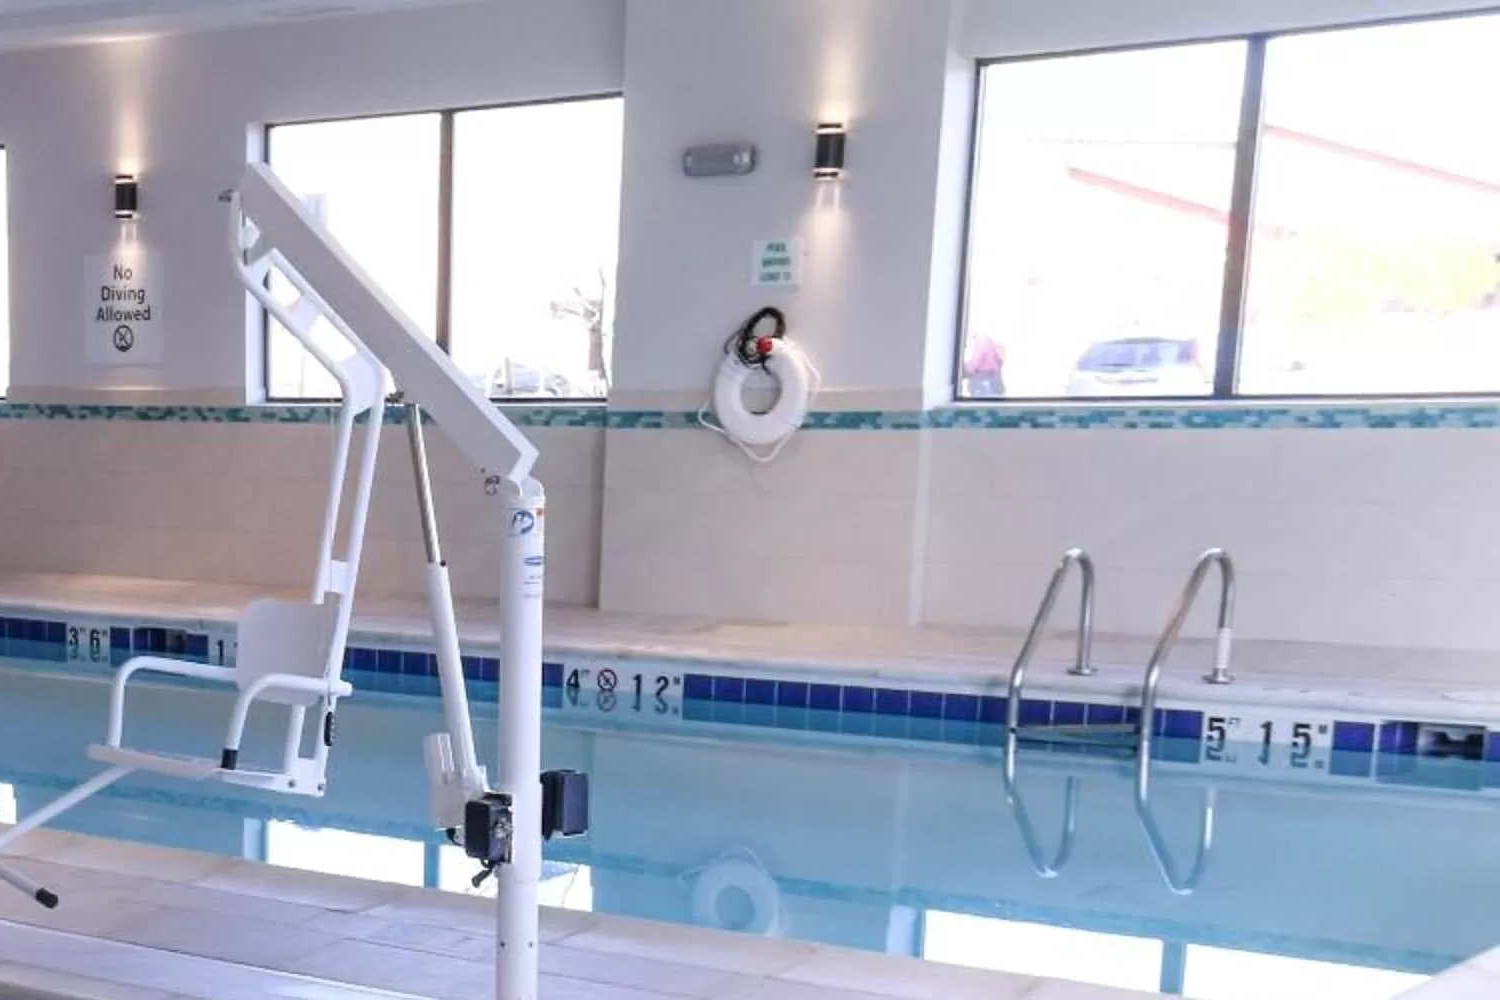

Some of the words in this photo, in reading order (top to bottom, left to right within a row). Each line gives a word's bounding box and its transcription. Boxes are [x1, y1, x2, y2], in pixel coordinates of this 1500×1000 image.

[113, 264, 133, 281] No
[101, 285, 145, 304] Diving
[96, 304, 151, 321] Allowed
